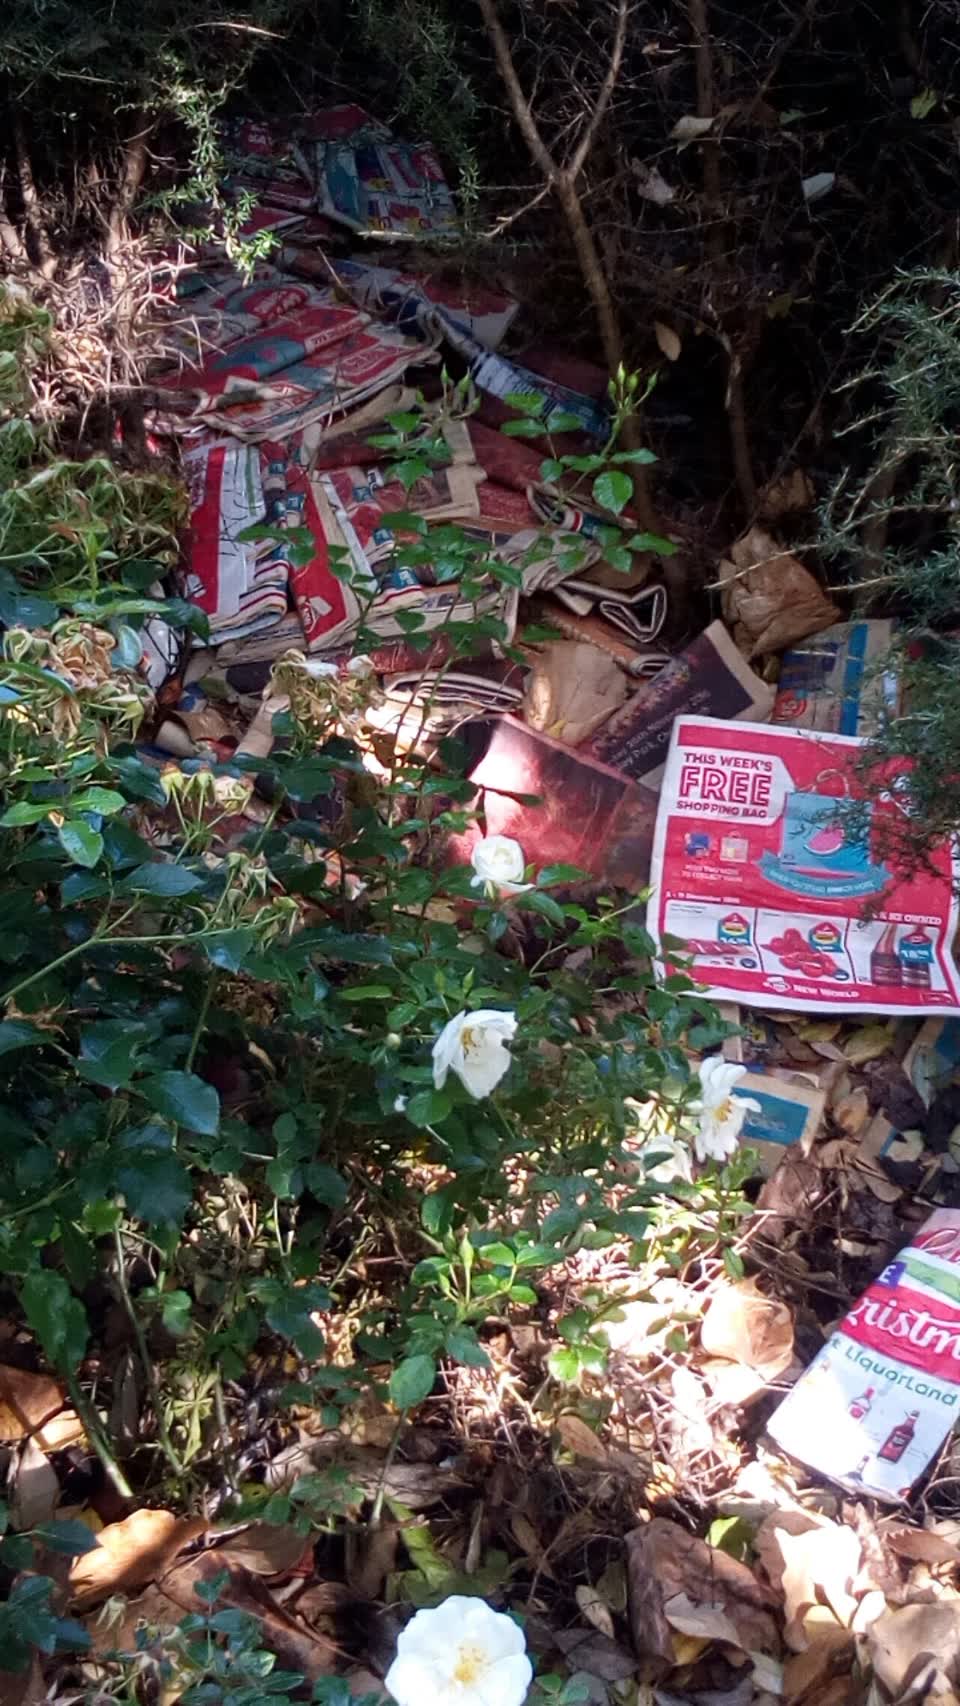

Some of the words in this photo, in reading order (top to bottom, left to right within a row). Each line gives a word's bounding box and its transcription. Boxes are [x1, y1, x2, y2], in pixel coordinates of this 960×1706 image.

[684, 752, 717, 765] THIS
[720, 755, 773, 772] WEEK'S
[679, 765, 772, 807] FREE
[676, 800, 740, 816] SHOPPING
[742, 806, 768, 819] BAG
[793, 983, 819, 995] NEW
[819, 987, 861, 999] WORLD
